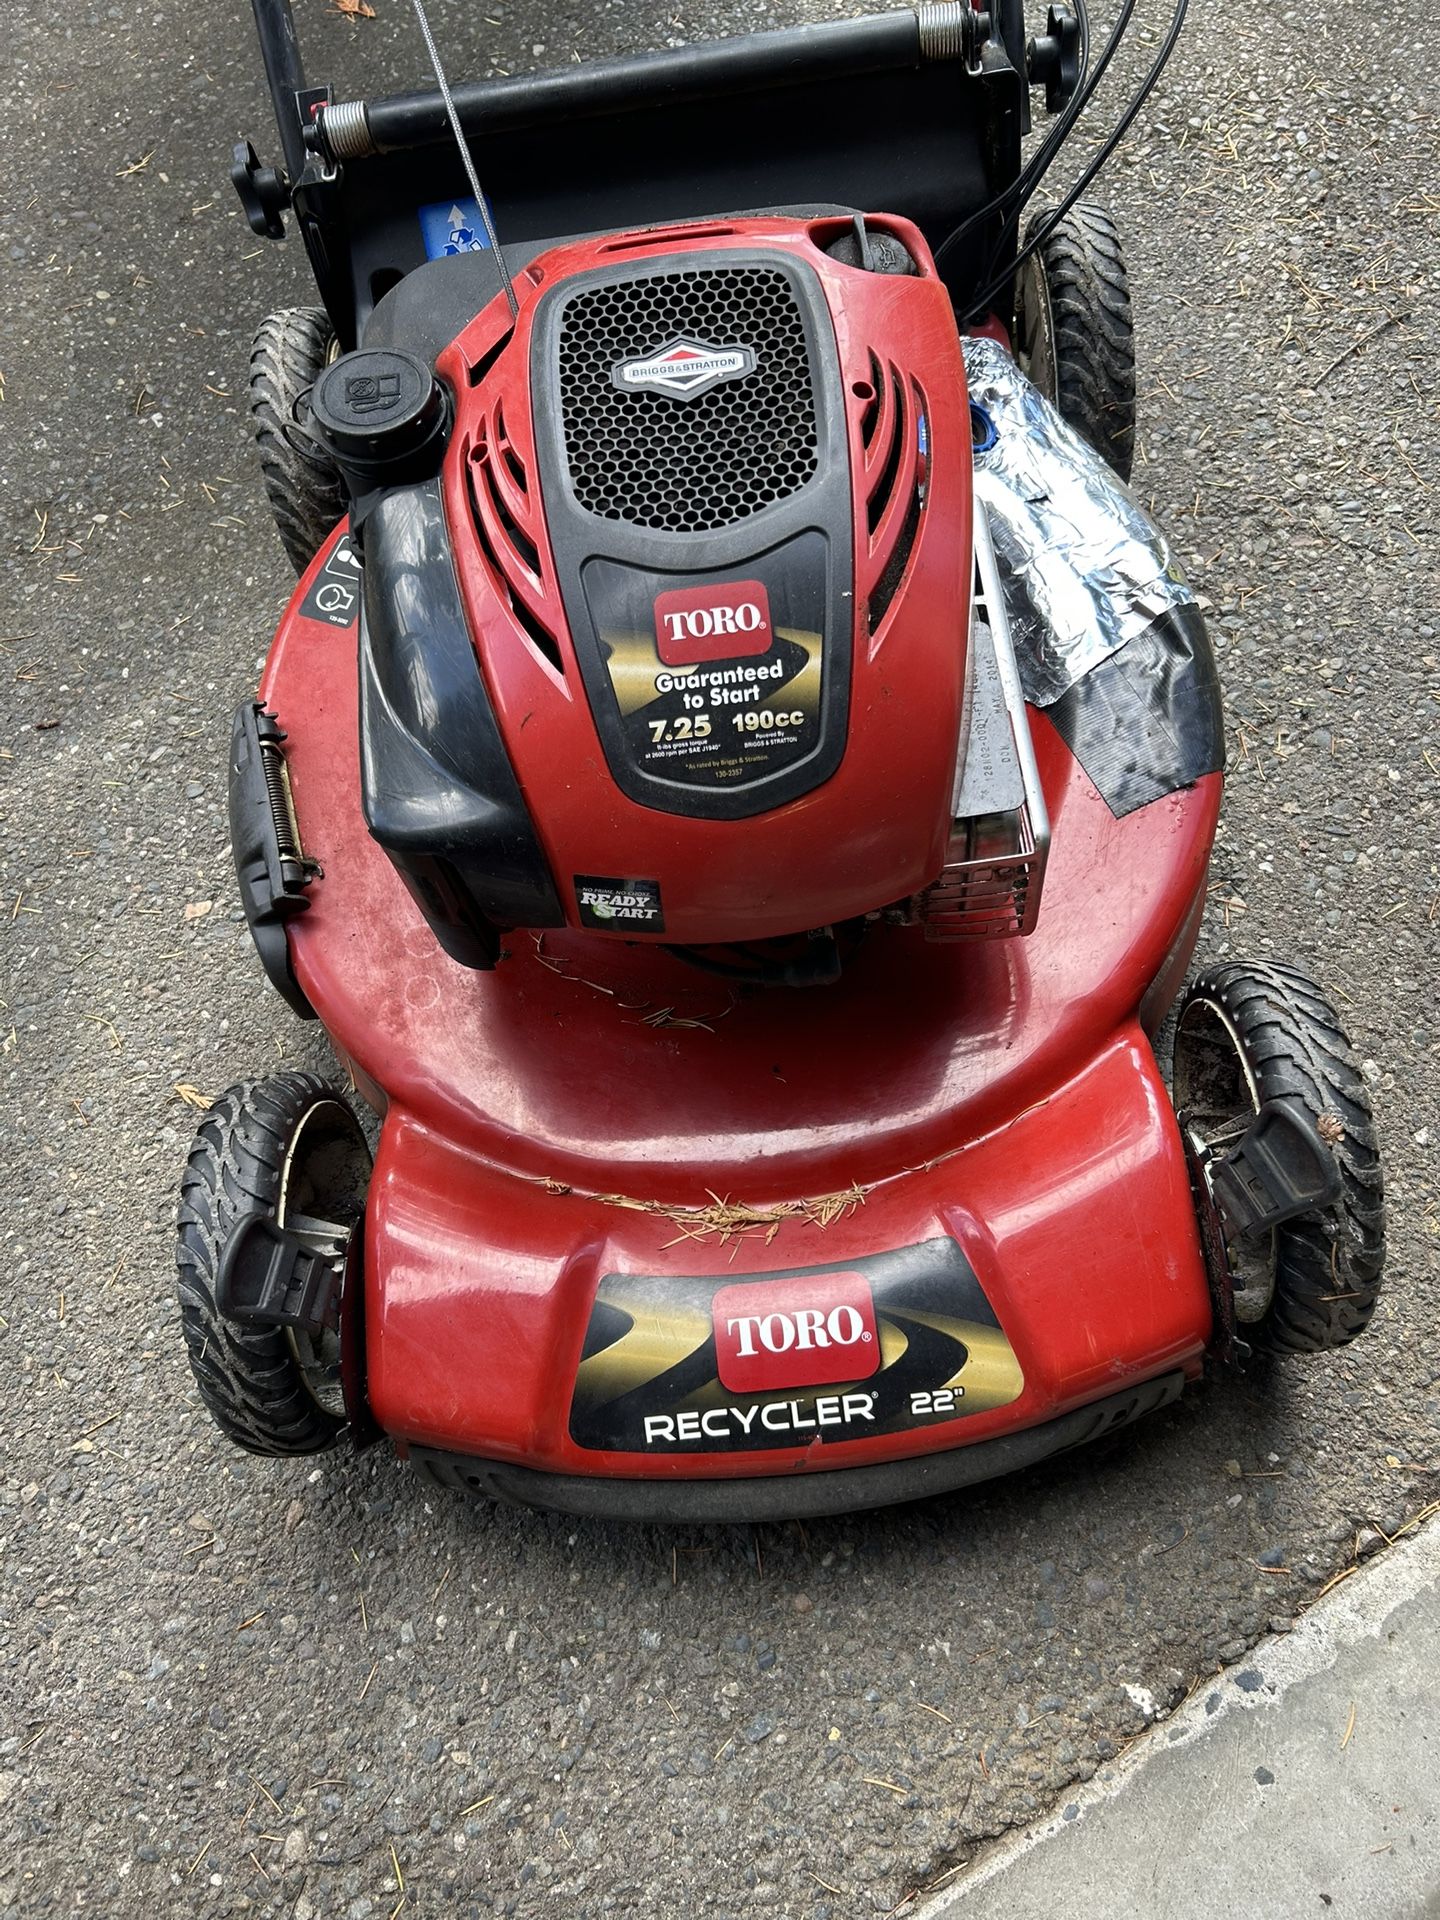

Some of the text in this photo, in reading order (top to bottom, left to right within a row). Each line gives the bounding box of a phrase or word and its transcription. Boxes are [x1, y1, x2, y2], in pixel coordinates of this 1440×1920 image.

[656, 659, 783, 693] Guaranteed
[683, 684, 760, 709] to Start
[648, 710, 804, 743] 7.25 190cc
[744, 741, 764, 749] BRIGGS
[770, 736, 798, 745] STRATTON
[581, 893, 650, 907] READY
[595, 904, 657, 919] START
